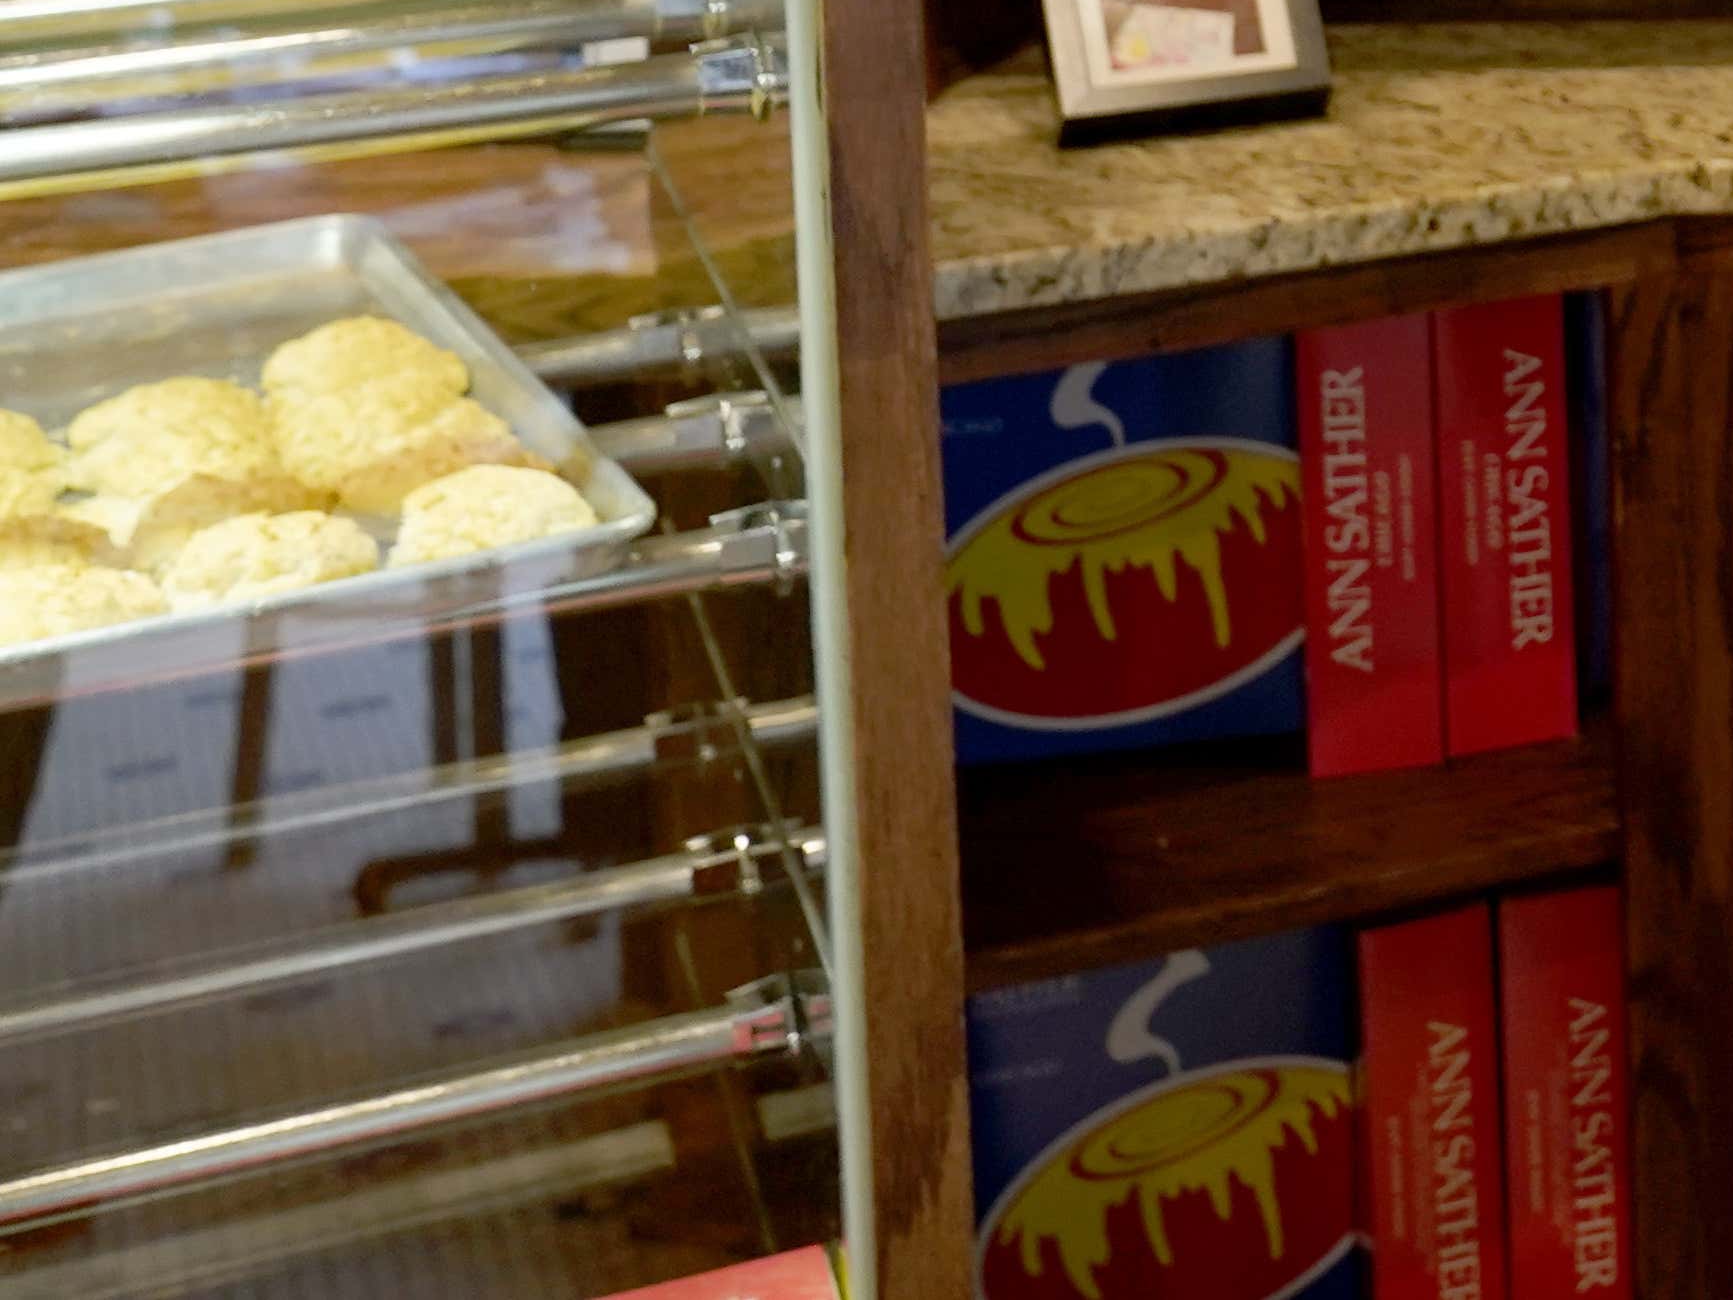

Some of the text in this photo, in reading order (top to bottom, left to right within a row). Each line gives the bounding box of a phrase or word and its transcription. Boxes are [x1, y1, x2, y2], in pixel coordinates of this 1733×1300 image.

[1321, 365, 1374, 671] ANN SATHER
[1503, 349, 1553, 650] ANN SATHER
[1427, 1021, 1472, 1131] ANN
[1568, 998, 1617, 1291] ANN SATHER
